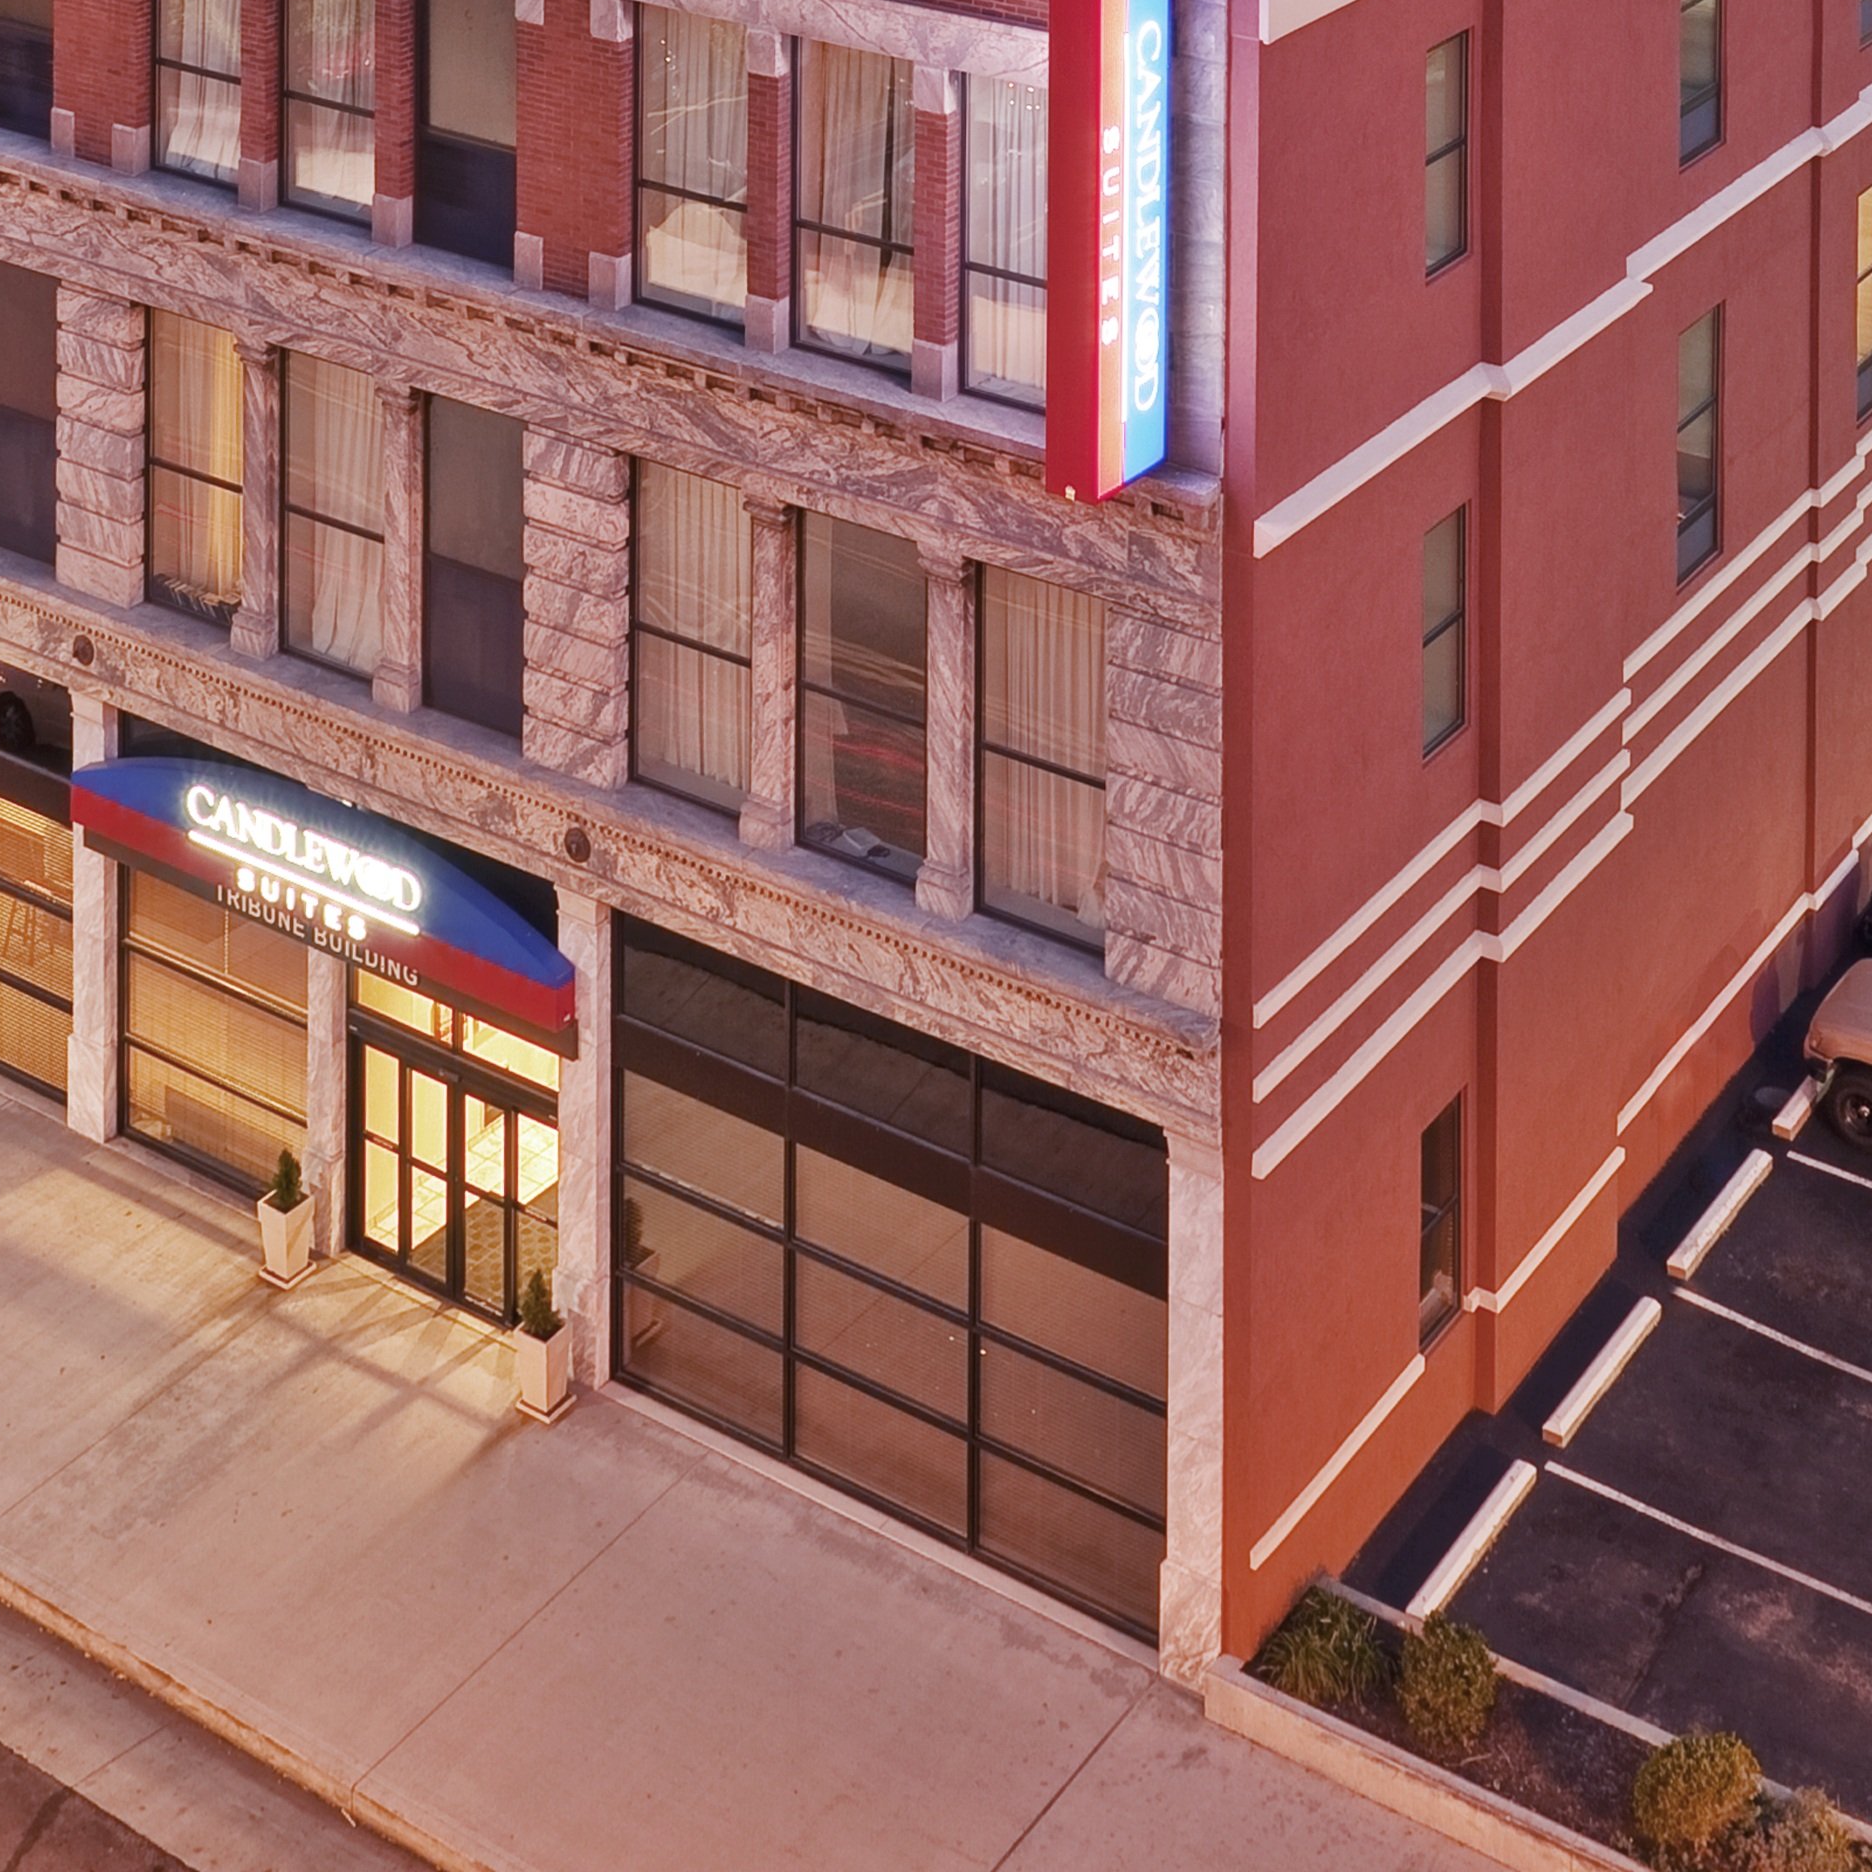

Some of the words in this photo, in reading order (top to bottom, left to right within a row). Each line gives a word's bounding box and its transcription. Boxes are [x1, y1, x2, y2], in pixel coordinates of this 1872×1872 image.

[1101, 124, 1121, 346] SUITES
[1133, 19, 1162, 412] CANDLEWOOD
[185, 784, 423, 912] CANDLEWOOD
[236, 867, 367, 941] SUITES
